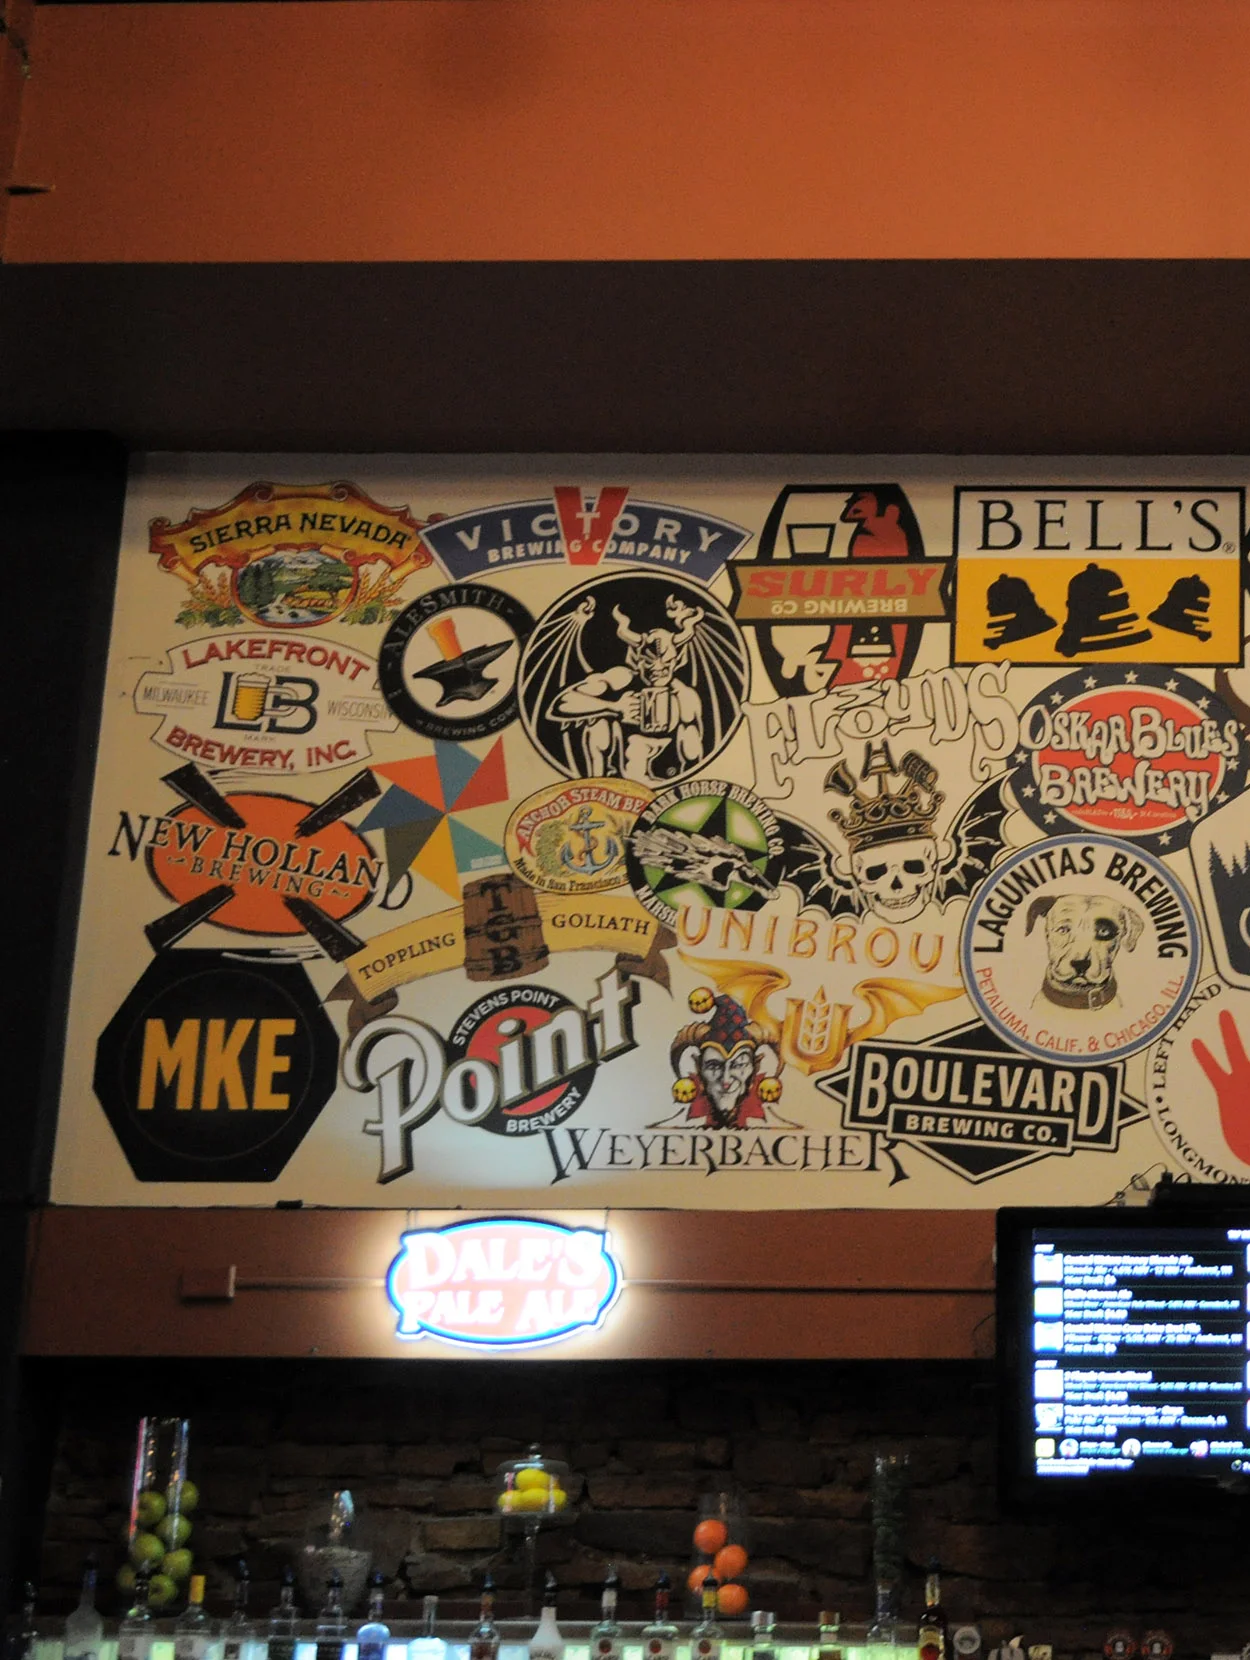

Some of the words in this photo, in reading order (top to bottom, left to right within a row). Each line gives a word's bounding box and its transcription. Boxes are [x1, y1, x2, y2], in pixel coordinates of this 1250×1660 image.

[189, 511, 292, 554] SIERRA
[299, 510, 412, 550] NEVADA
[456, 511, 723, 553] VICTORY
[487, 538, 582, 565] BREWING
[592, 539, 691, 565] COMPANY
[976, 498, 1222, 554] BELL'S
[746, 567, 938, 599] SURLY
[803, 598, 908, 615] BREWING
[384, 588, 507, 655] ALESMITH
[181, 637, 373, 681] LAKEFRONT
[142, 685, 210, 706] MILWAUKEE
[327, 700, 395, 719] WISCONSIN
[166, 726, 296, 770] BREWERY,
[306, 739, 357, 768] INC.
[1019, 704, 1131, 766] OSKAR
[1130, 705, 1240, 760] BLUES
[517, 796, 571, 842] ANCHOR
[570, 787, 621, 810] STEAM
[621, 797, 646, 813] BE
[642, 790, 681, 825] DARK
[678, 779, 729, 799] HORSE
[728, 784, 782, 837] BREWING
[1038, 760, 1212, 823] BREWERY
[108, 810, 214, 862] NEW
[222, 831, 414, 911] HOLLAND
[190, 857, 326, 899] BREWING
[513, 857, 536, 883] Made
[536, 878, 546, 887] in
[547, 879, 567, 891] San
[552, 912, 651, 937] GOLIATH
[635, 884, 678, 929] MARSH
[973, 846, 1096, 953] LAGUNITAS
[1104, 851, 1189, 959] BREWING
[358, 932, 457, 981] TOPPLING
[675, 904, 960, 977] UNIBROU
[452, 991, 510, 1047] STEVENS
[511, 989, 560, 1009] POINT
[976, 966, 1030, 1041] PETALUMA,
[1034, 1029, 1083, 1053] CALIF.
[1087, 1036, 1100, 1052] &
[1103, 1000, 1171, 1050] CHICAGO,
[1160, 974, 1185, 1000] ILL.
[1153, 1034, 1175, 1091] LEFT
[1173, 983, 1223, 1033] HAND
[136, 1017, 297, 1112] MKE
[341, 966, 642, 1185] Point
[505, 1087, 583, 1134] BREWERY
[857, 1051, 1110, 1137] BOULEVARD
[539, 1126, 911, 1187] WEYERBACHER
[905, 1114, 1014, 1141] BREWING
[1022, 1125, 1058, 1144] CO.
[401, 1230, 605, 1288] DALE'S
[400, 1289, 505, 1332] PALE
[515, 1288, 598, 1332] ALE
